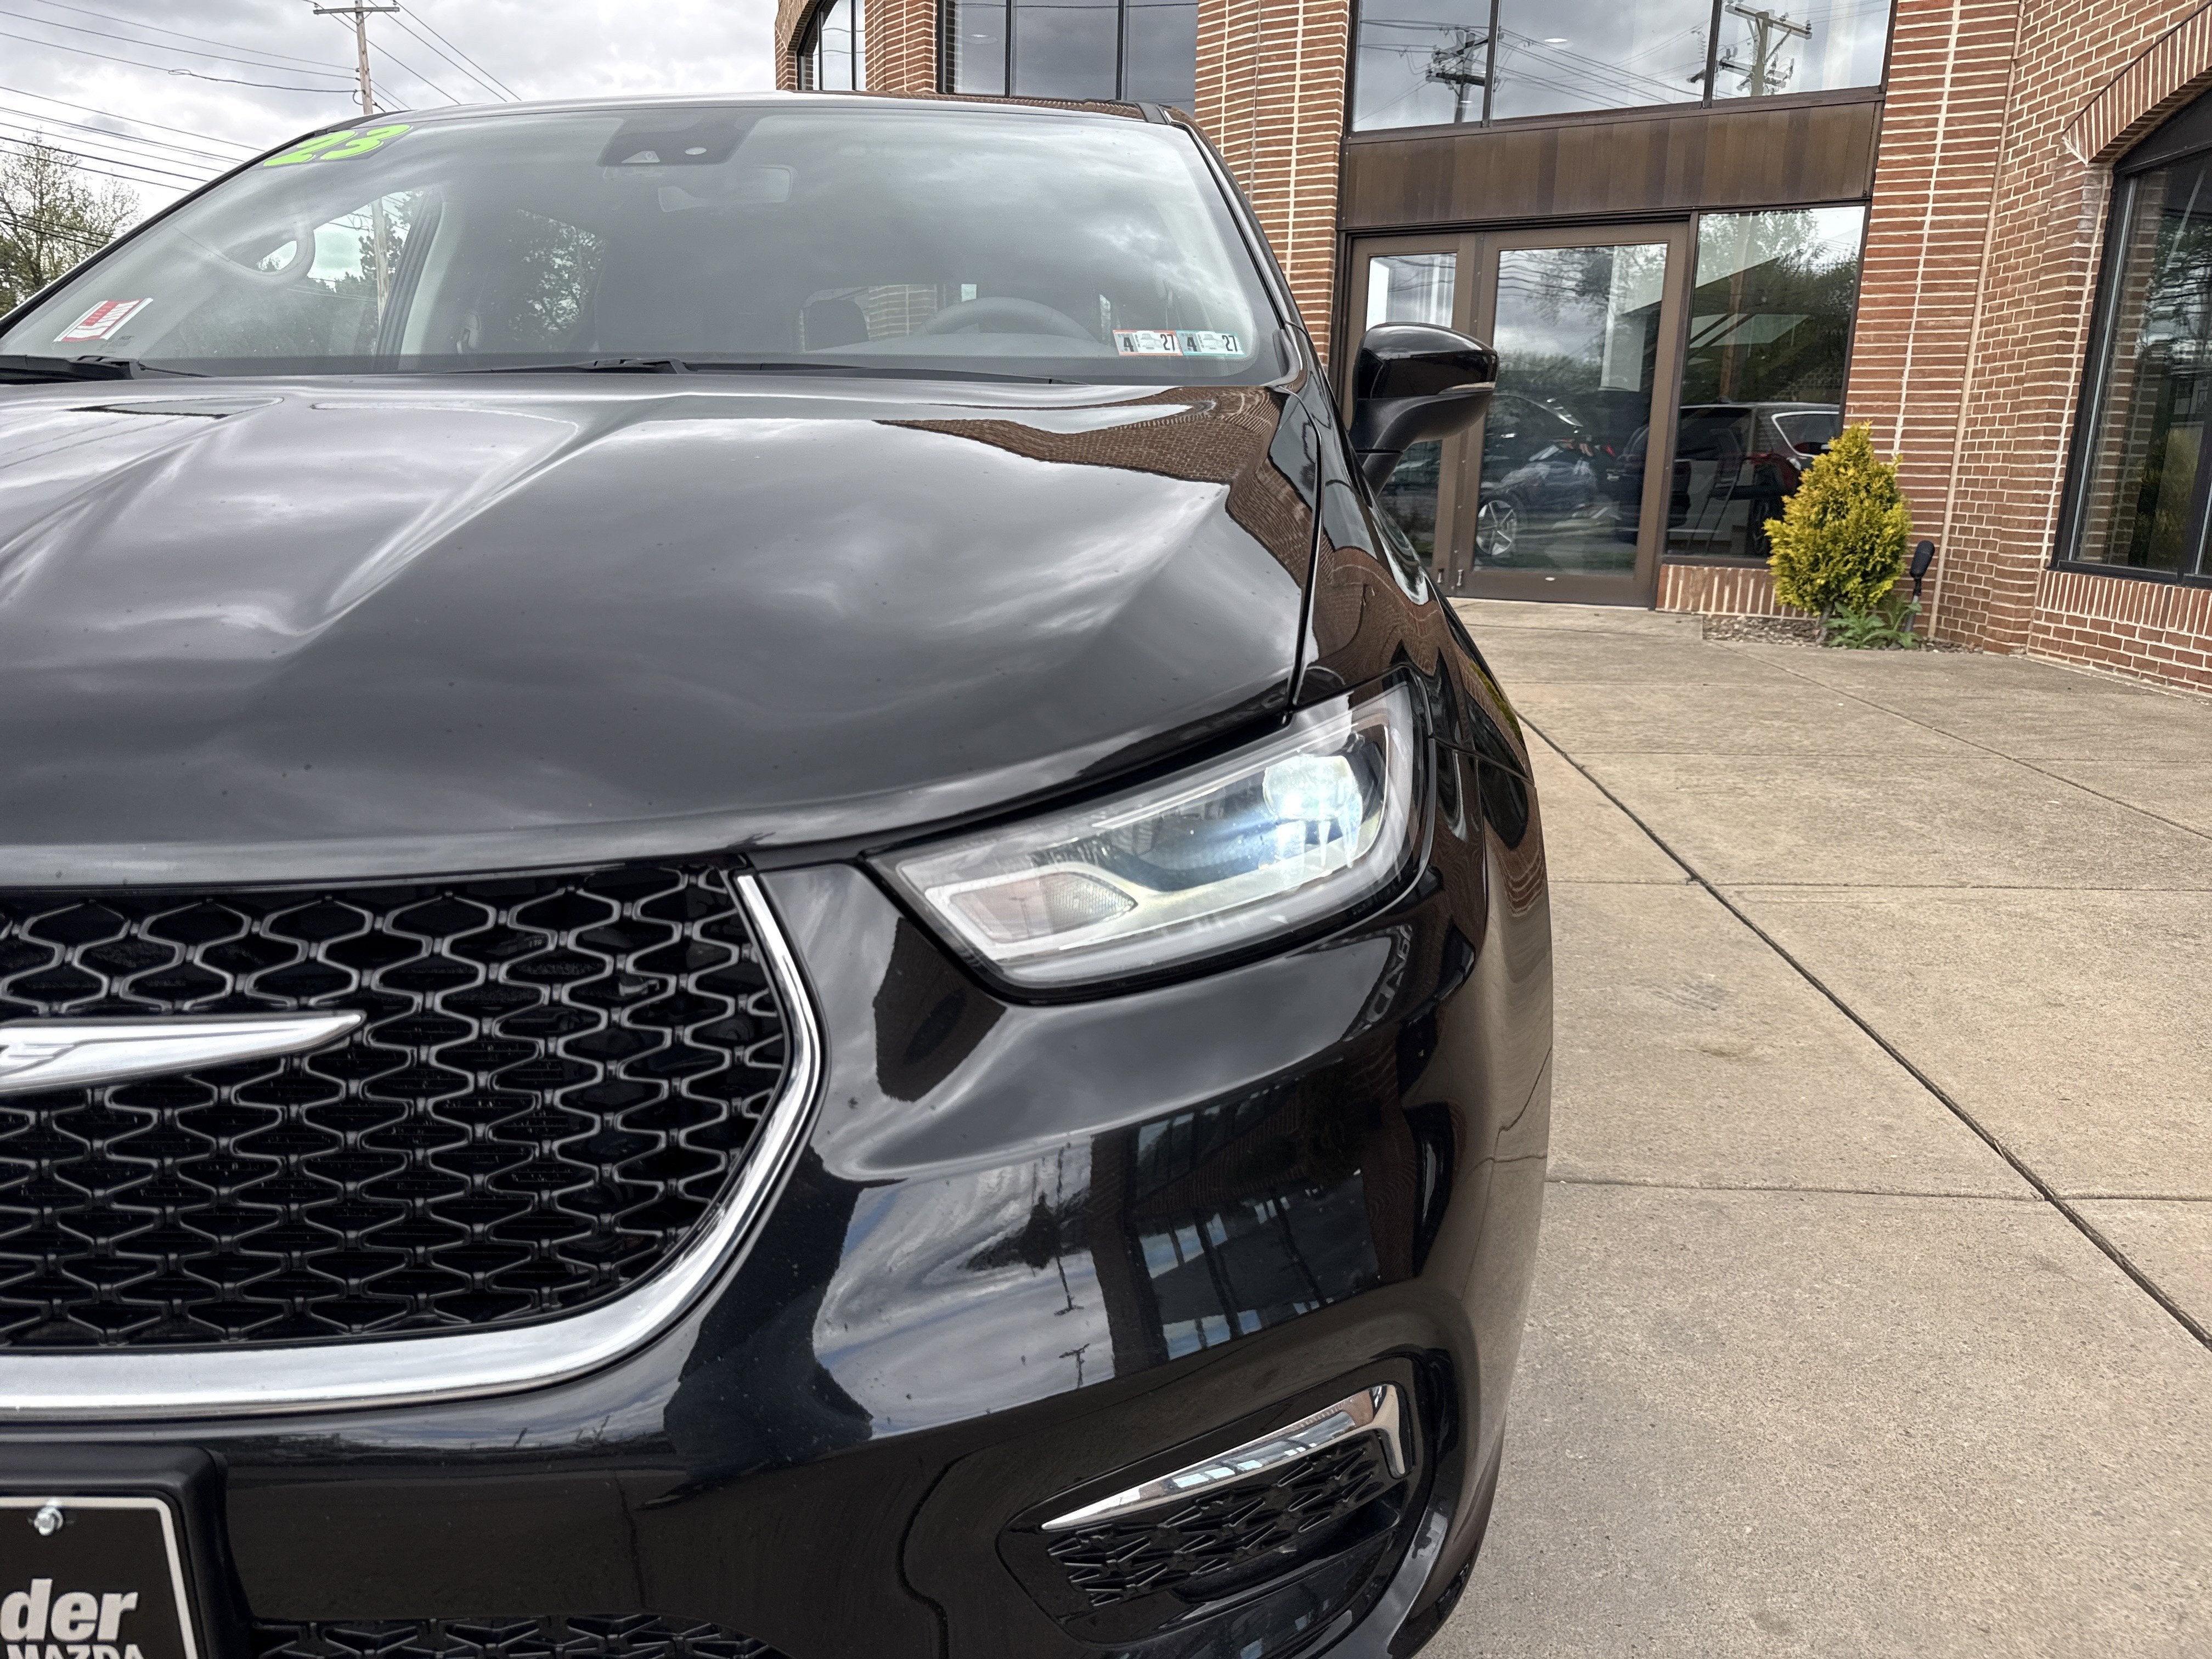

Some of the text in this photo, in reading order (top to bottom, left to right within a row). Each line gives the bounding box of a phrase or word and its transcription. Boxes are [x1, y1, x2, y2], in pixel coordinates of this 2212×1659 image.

[263, 125, 413, 167] 23
[1124, 337, 1135, 352] 4
[1160, 334, 1175, 351] 27
[1187, 336, 1198, 352] 4
[1221, 335, 1238, 352] 27
[0, 1578, 138, 1643] der
